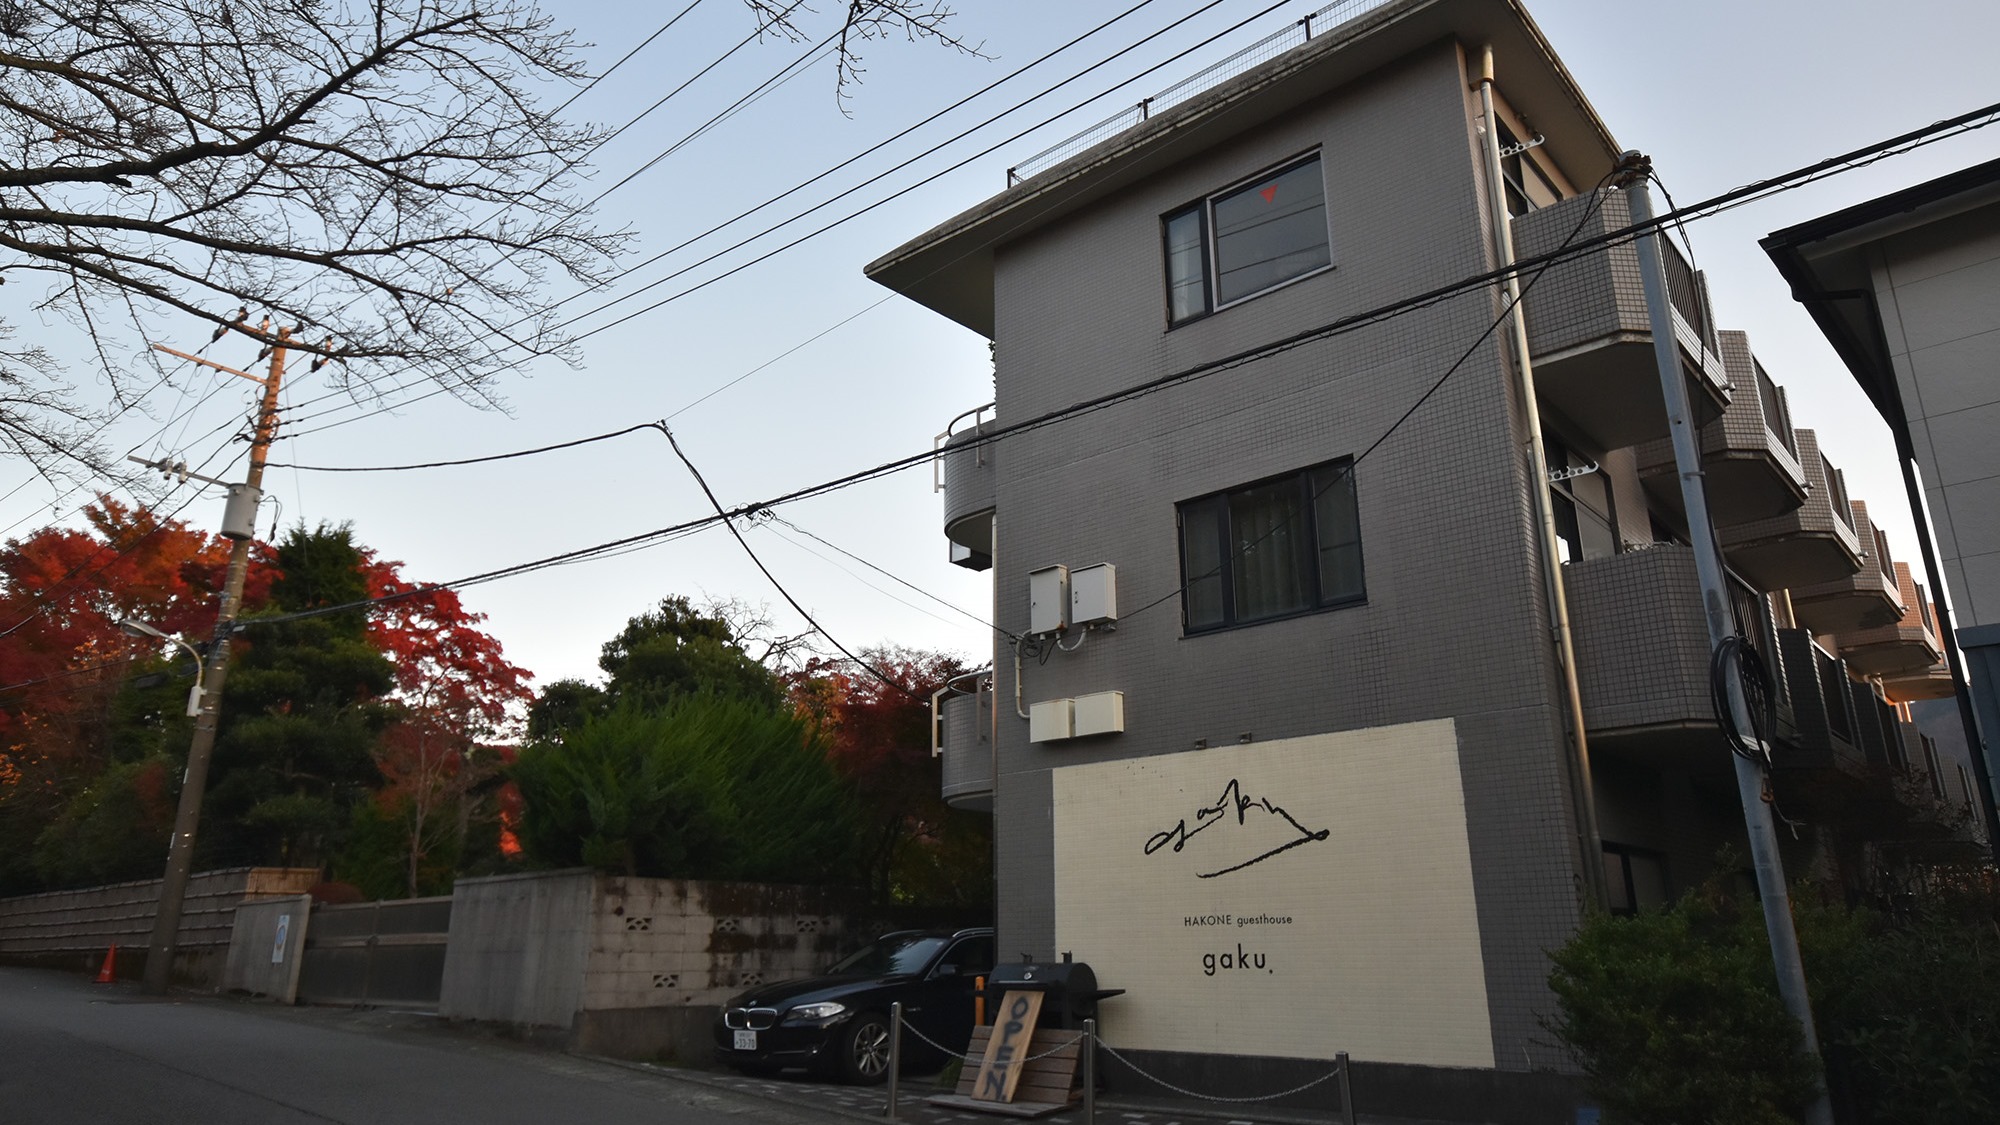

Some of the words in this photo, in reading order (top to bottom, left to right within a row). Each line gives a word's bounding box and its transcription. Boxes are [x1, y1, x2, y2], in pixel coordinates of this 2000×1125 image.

[1184, 914, 1232, 927] HAKONE
[1236, 913, 1293, 928] guesthouse
[983, 996, 1028, 1100] OPEN
